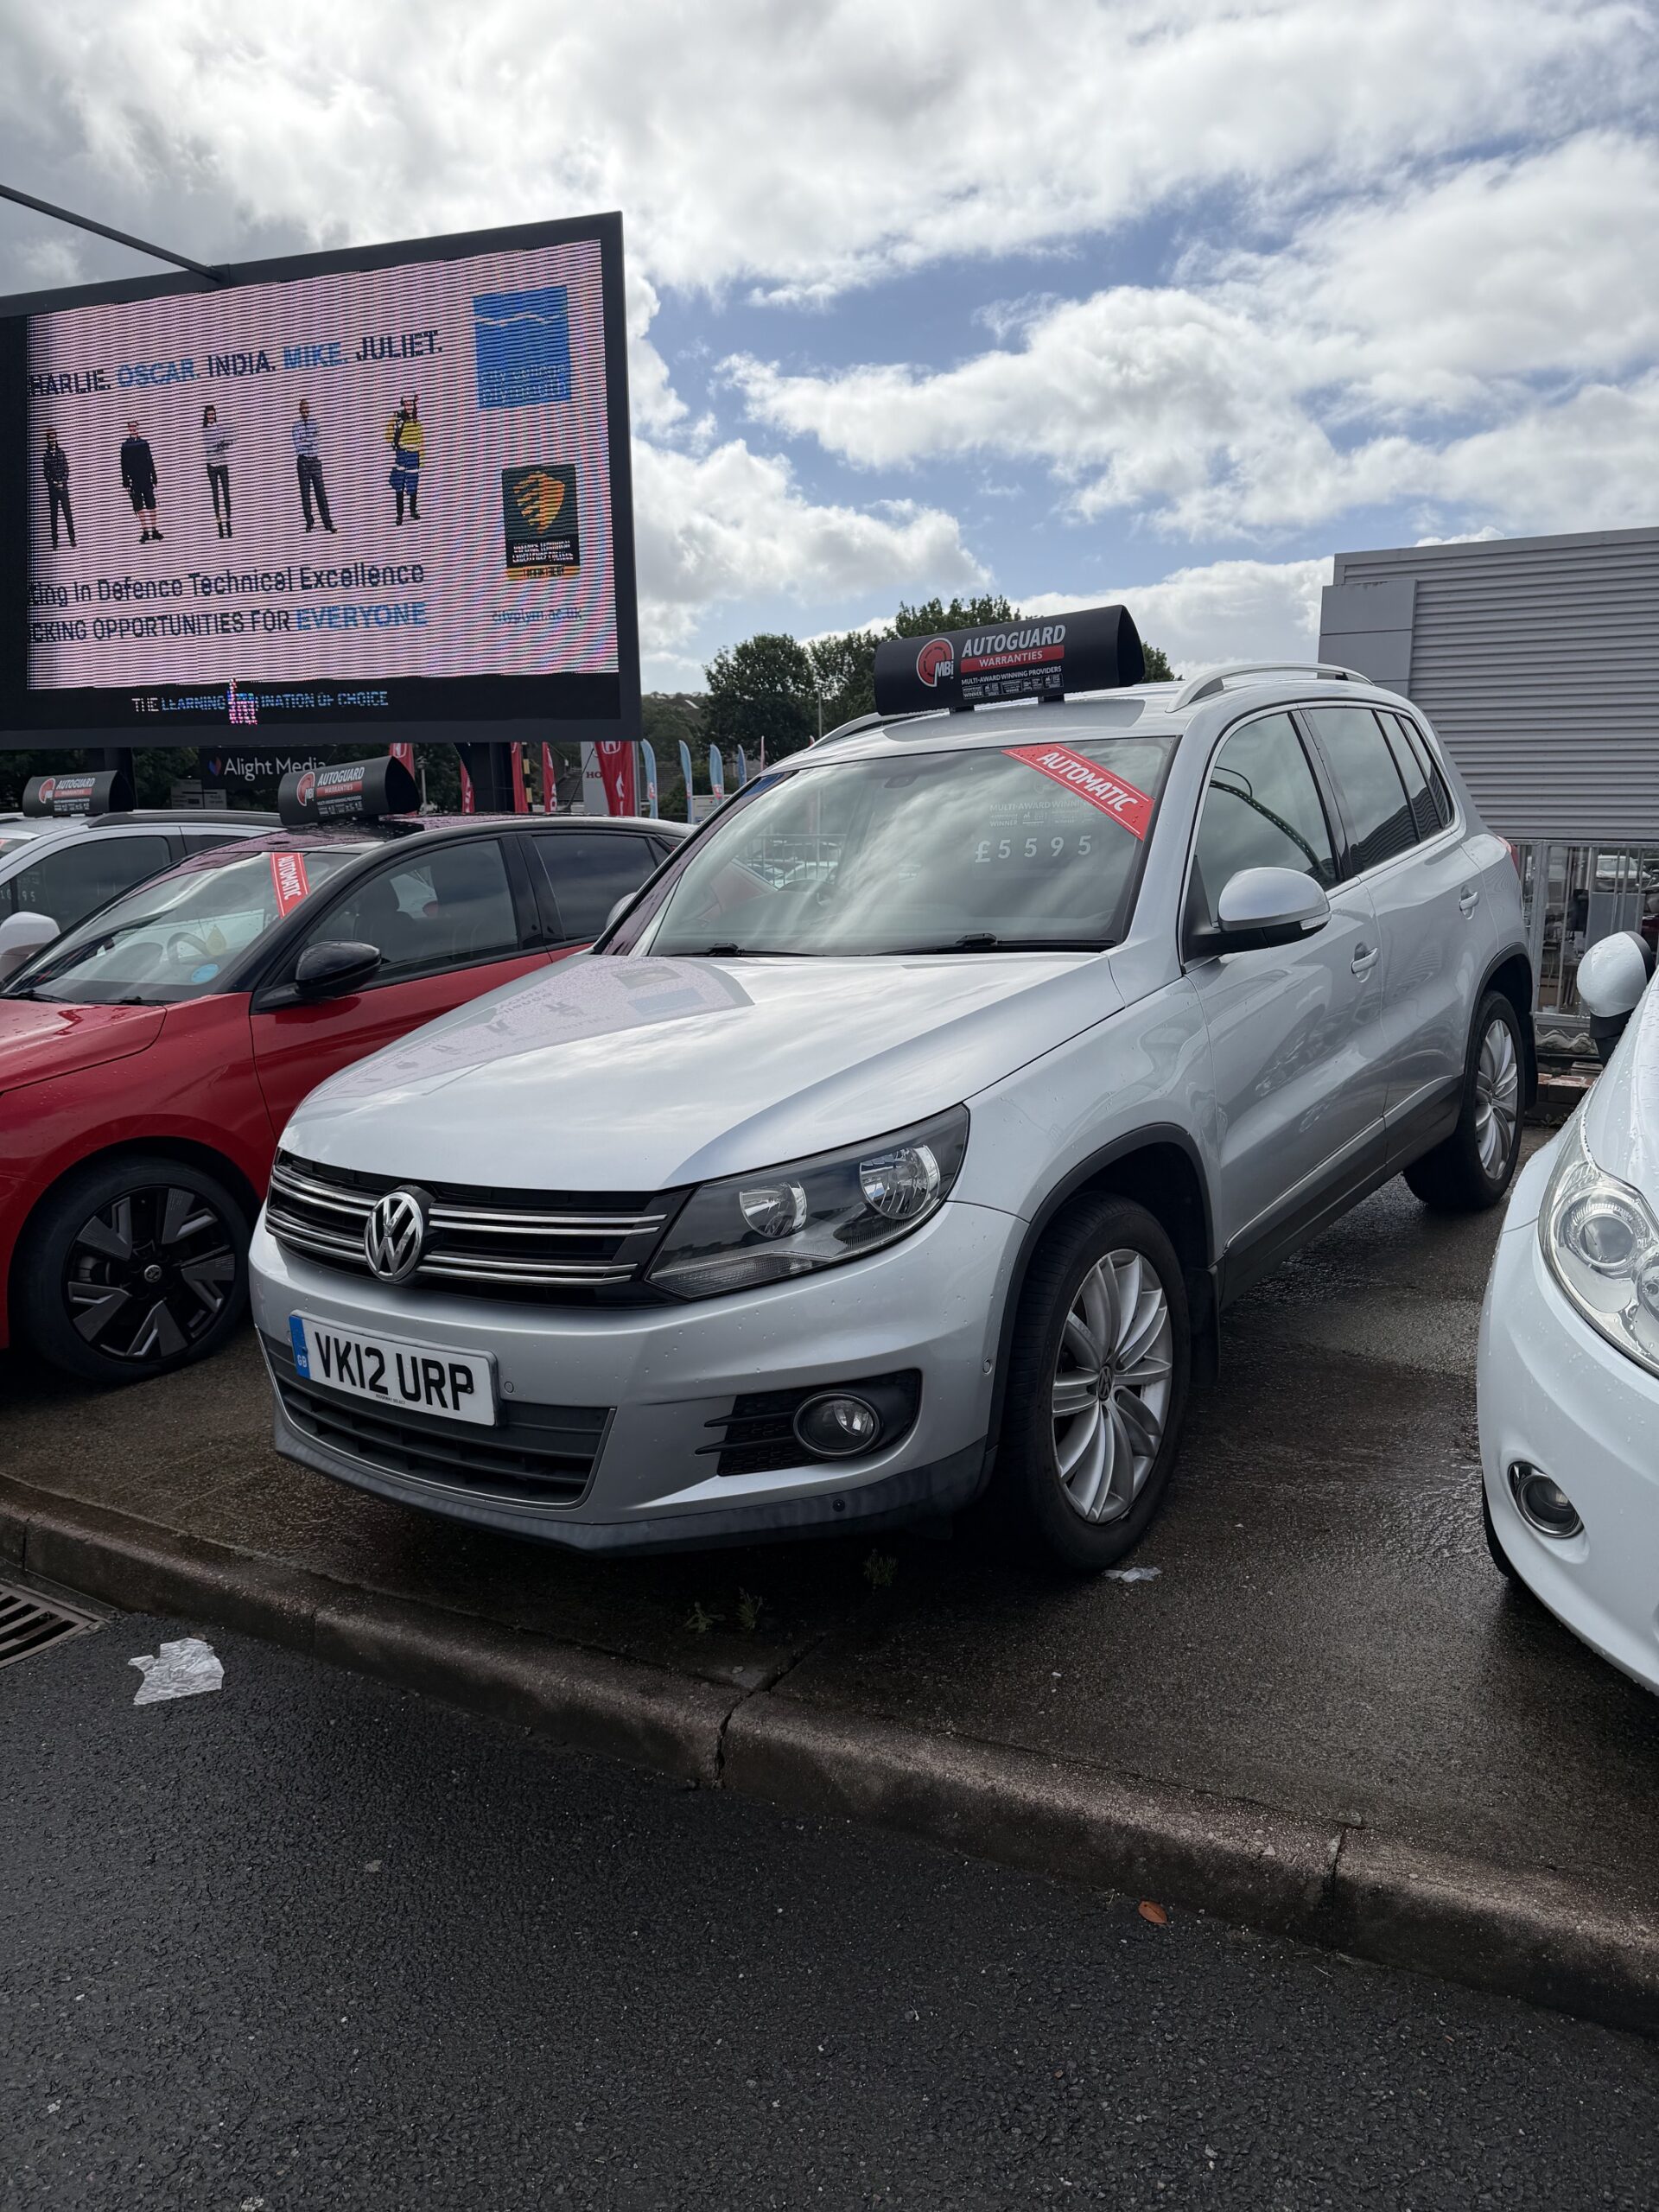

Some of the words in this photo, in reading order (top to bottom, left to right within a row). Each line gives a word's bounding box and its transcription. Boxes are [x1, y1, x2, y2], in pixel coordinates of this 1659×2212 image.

[208, 350, 276, 378] INDIA.
[356, 330, 443, 362] JULIET.
[98, 575, 183, 601] Defence
[188, 566, 293, 597] Technical
[300, 562, 425, 590] Excellence
[93, 610, 244, 639] OPPORTUNITIES
[251, 608, 290, 632] FOR
[296, 602, 429, 631] EVERYONE
[961, 625, 1066, 658] AUTOGUARD
[979, 651, 1043, 668] WARRANTIES
[961, 675, 1001, 685] MULTI-AWARD
[1001, 671, 1028, 680] WINNING
[1028, 665, 1062, 676] PROVIDERS
[131, 697, 160, 712] THE
[161, 695, 226, 711] LEARNING
[317, 692, 334, 707] OF
[337, 691, 389, 707] CHOICE
[224, 756, 271, 781] Alight
[317, 766, 365, 786] AUTOGUARD
[1036, 752, 1139, 812] AUTOMATIC
[56, 777, 96, 790] AUTOGUARD
[277, 855, 302, 900] AUTOMATIC
[296, 1354, 308, 1368] GB
[314, 1332, 389, 1395] VK12
[396, 1352, 474, 1411] URP
